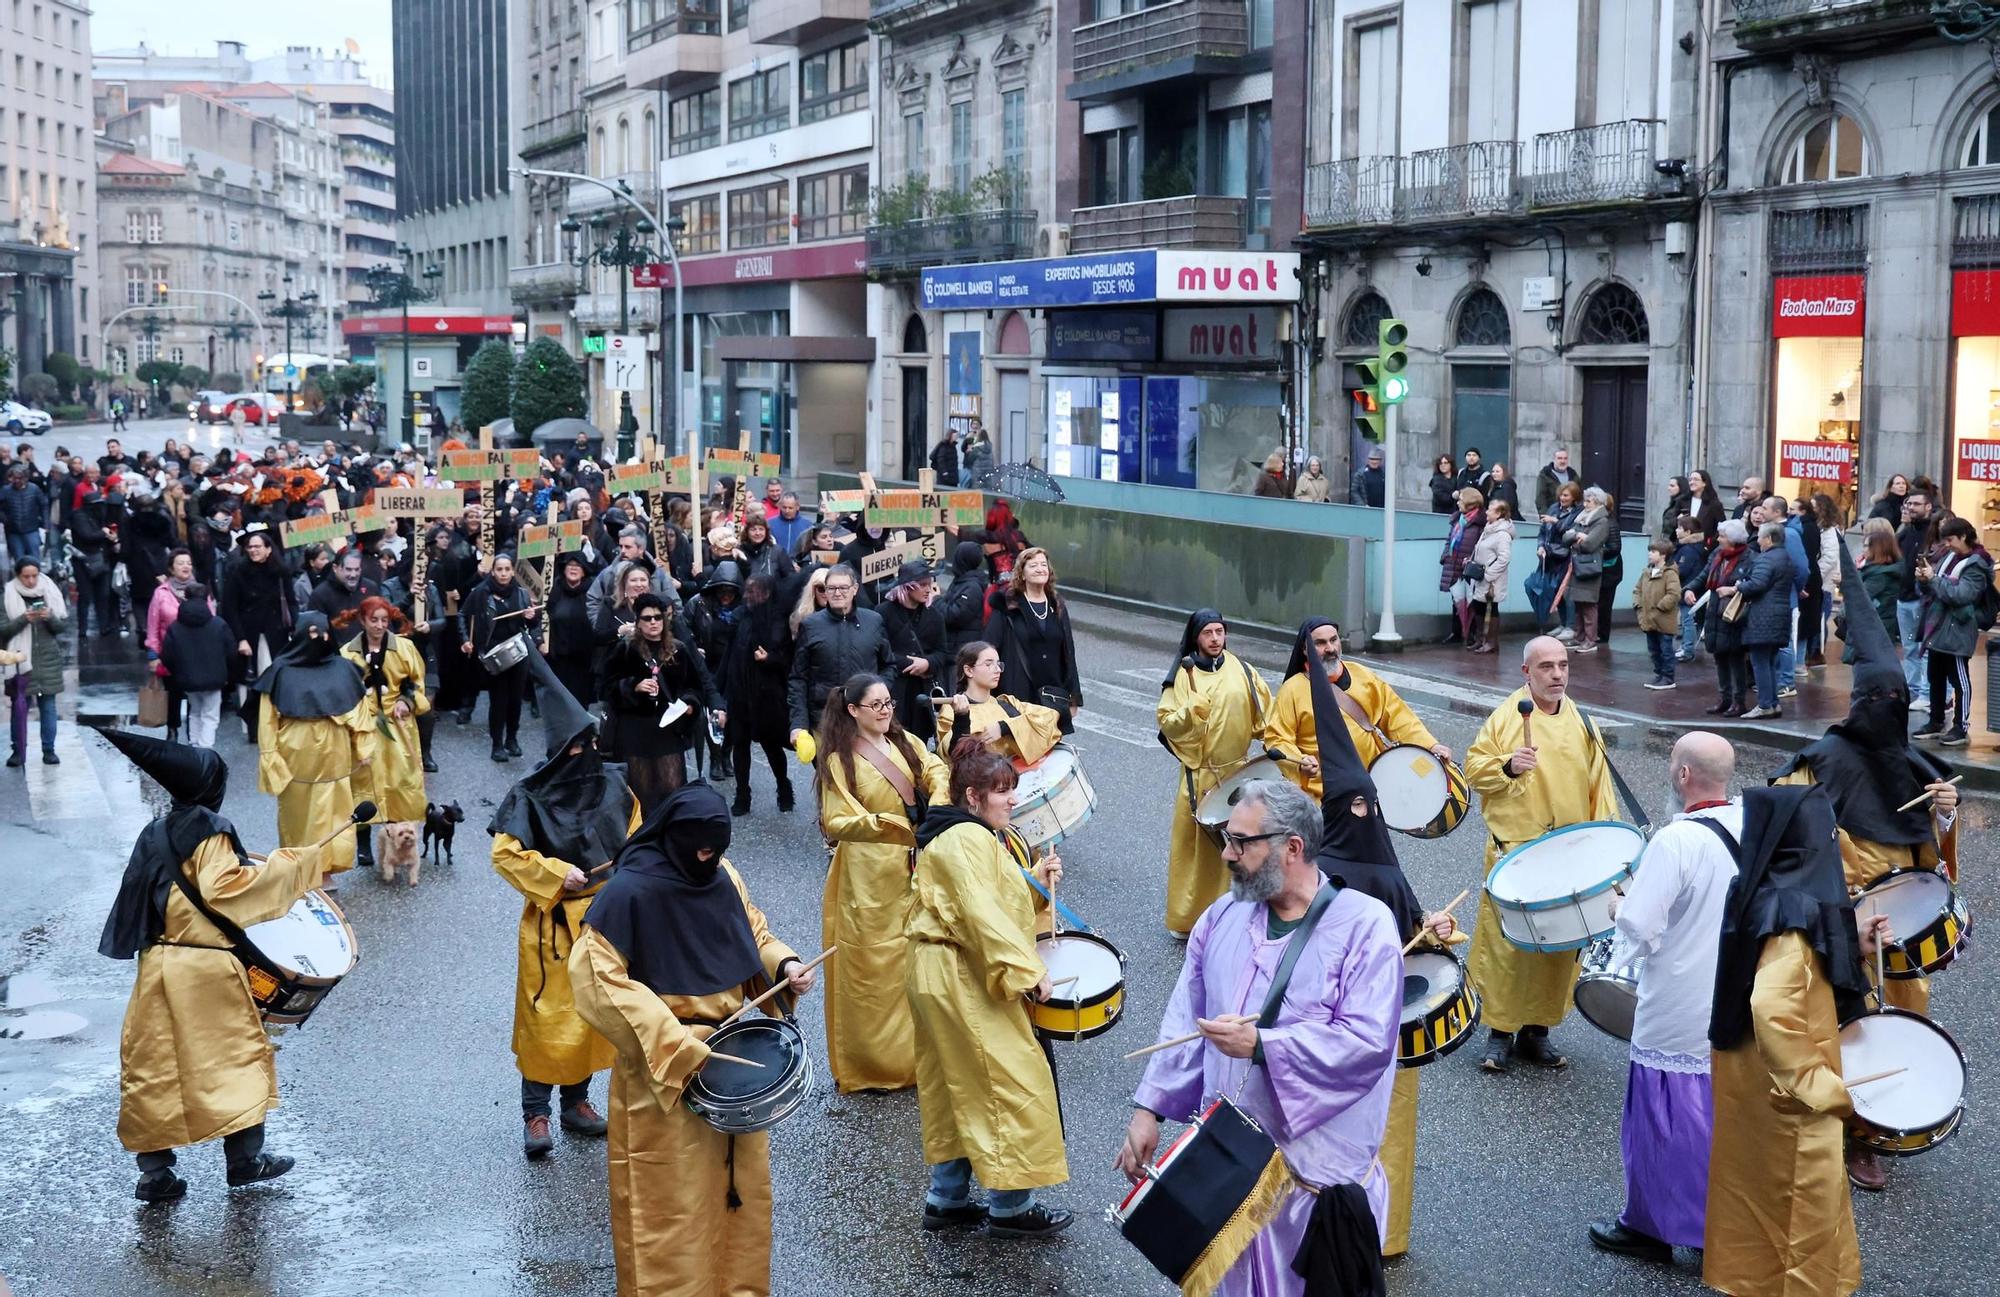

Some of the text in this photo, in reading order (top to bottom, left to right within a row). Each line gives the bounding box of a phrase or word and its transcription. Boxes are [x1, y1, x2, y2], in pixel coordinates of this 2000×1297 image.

[1045, 261, 1135, 282] EXPERTOS INMOBILIARIOS
[1178, 260, 1277, 291] muat
[934, 280, 993, 297] COLDWELL BANKER
[999, 275, 1016, 286] INDIGO
[1093, 279, 1135, 295] DESDE 1906
[999, 285, 1029, 297] REAL ESTATE
[1781, 297, 1855, 316] Foot on Mars
[1190, 314, 1258, 356] muat
[1783, 443, 1849, 463] LIQUIDACIÓN
[1961, 443, 2000, 461] LIQUID
[441, 454, 450, 468] A
[504, 463, 511, 478] E
[608, 469, 616, 482] A
[665, 472, 672, 485] E
[753, 464, 759, 477] E
[1791, 461, 1840, 480] DE STOCK
[1971, 462, 1987, 479] DE
[381, 496, 425, 511] LIBERAR
[868, 494, 878, 509] A
[922, 494, 940, 508] FAI
[940, 509, 948, 524] E
[865, 553, 904, 576] LIBERAR
